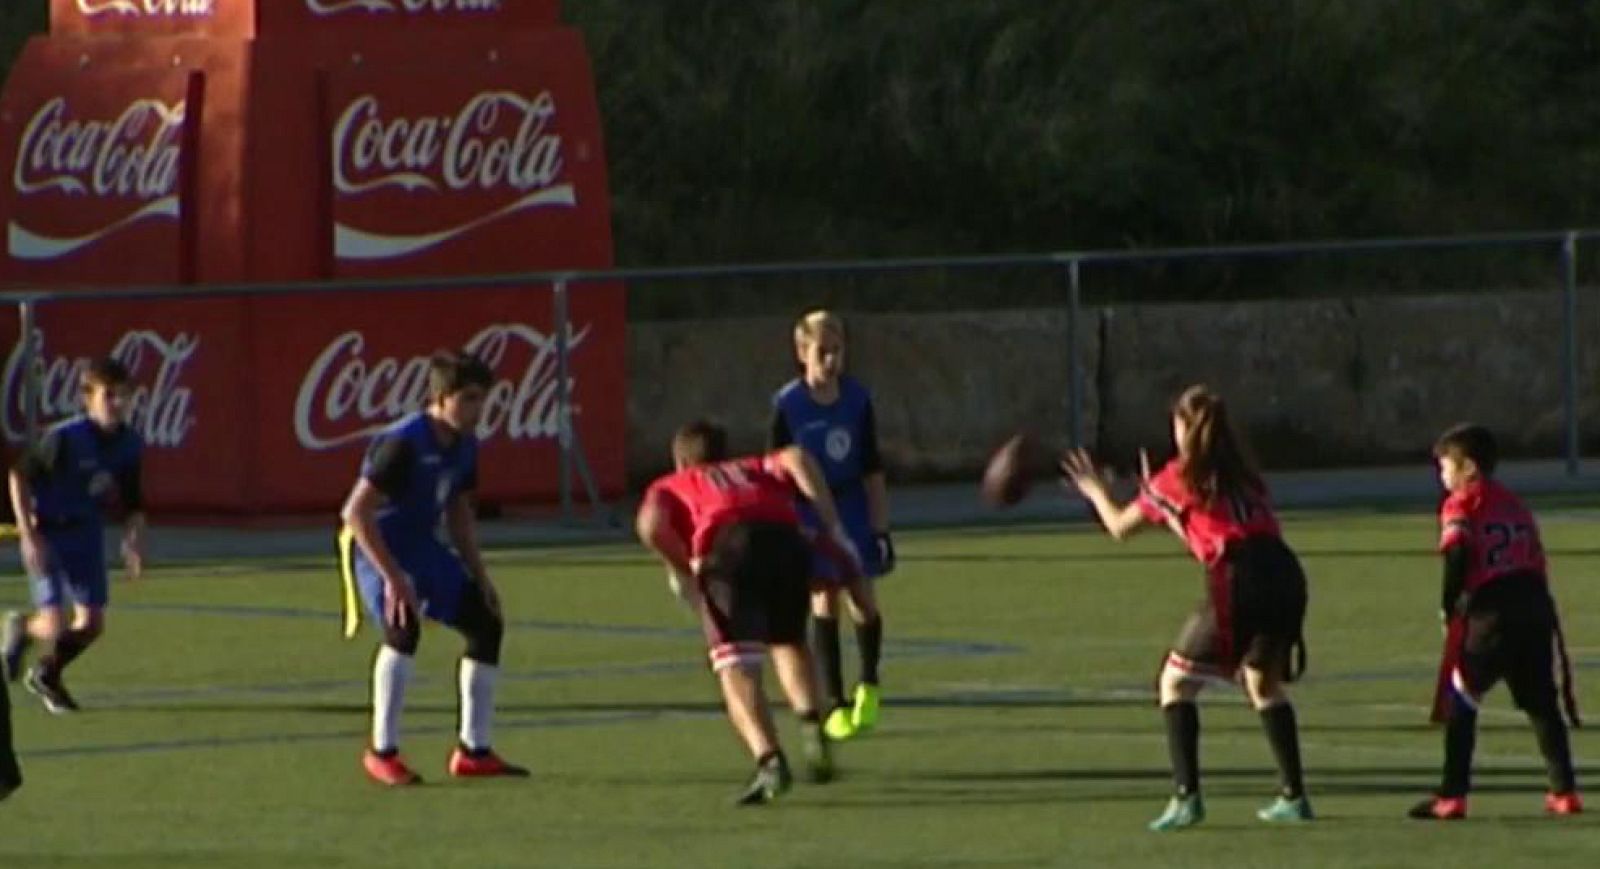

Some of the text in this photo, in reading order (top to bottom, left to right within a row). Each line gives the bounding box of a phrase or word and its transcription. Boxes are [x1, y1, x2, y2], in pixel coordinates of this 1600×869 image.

[333, 90, 563, 194] Coca-Cola
[3, 328, 199, 446] Cocaola
[294, 322, 591, 448] Cocaola
